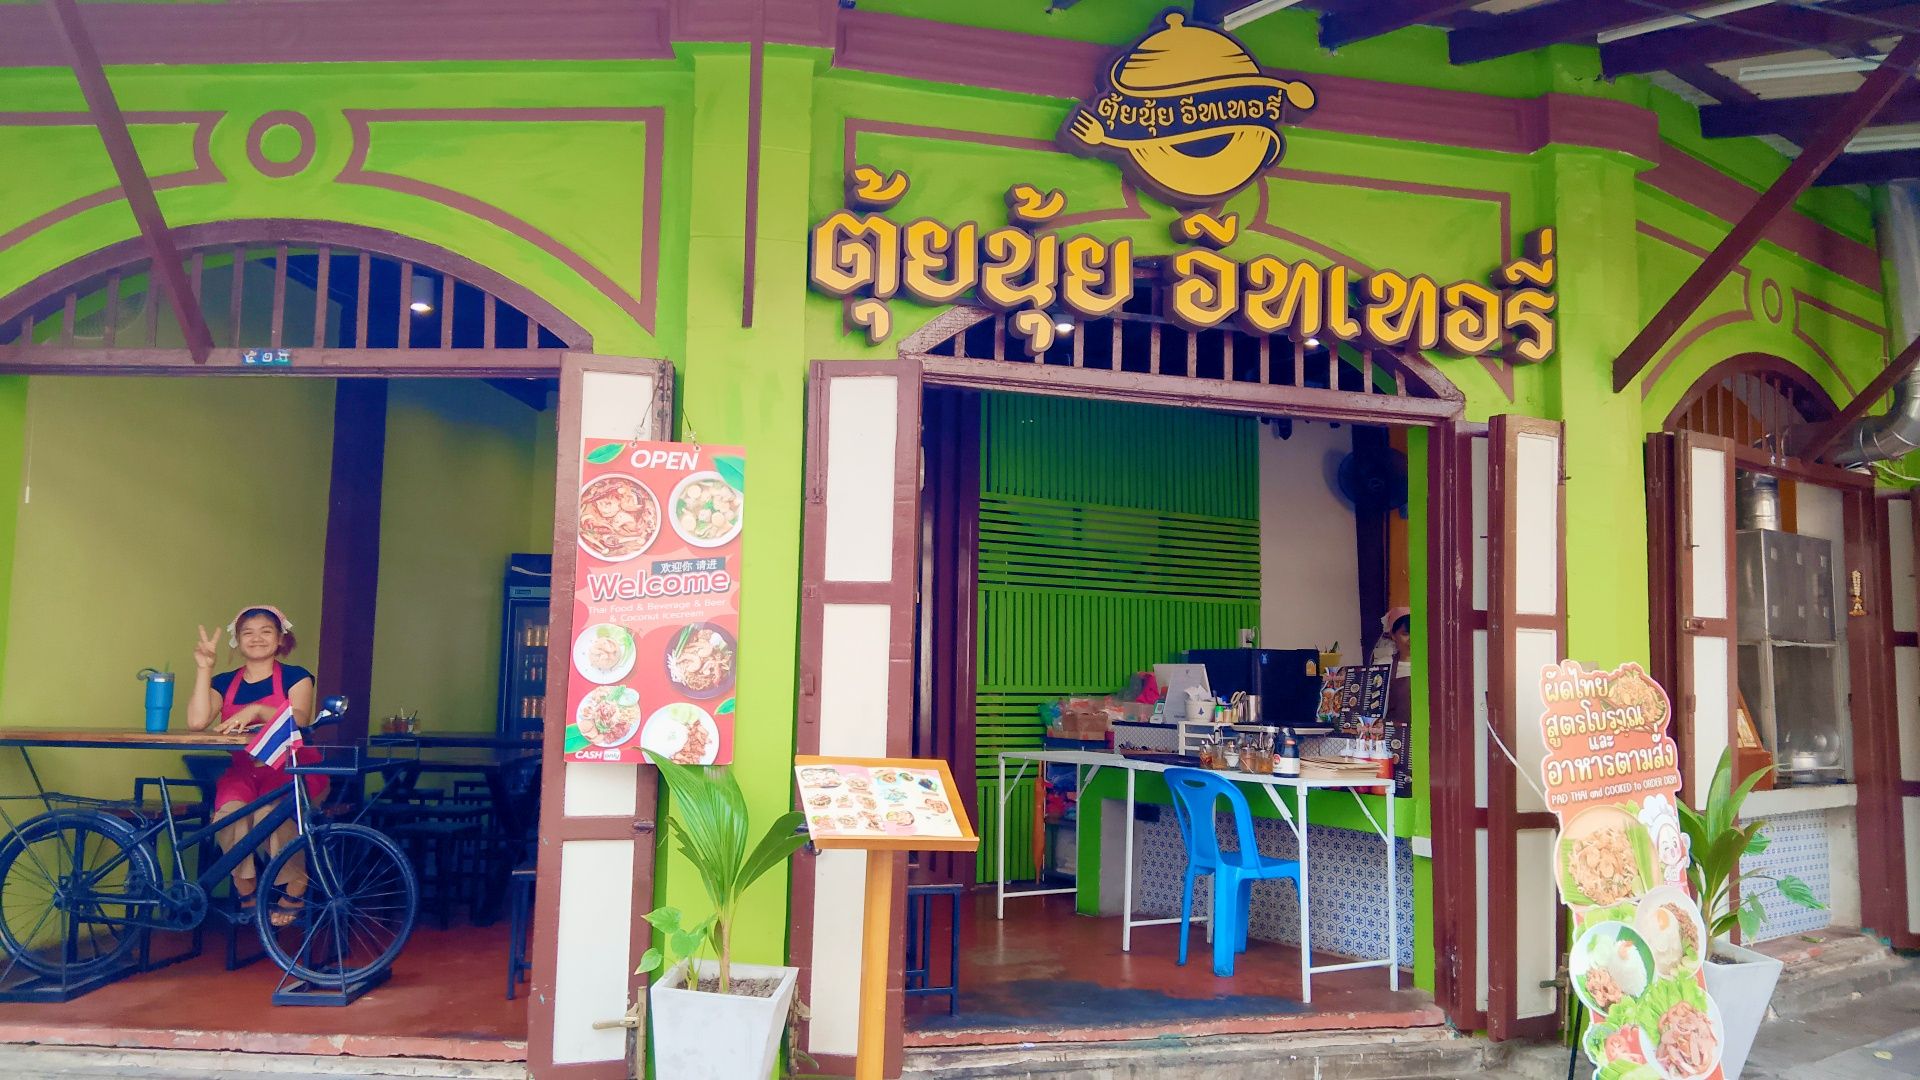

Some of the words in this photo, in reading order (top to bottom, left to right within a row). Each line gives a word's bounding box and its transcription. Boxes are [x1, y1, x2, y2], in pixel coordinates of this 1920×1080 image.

[810, 166, 1133, 351] ตุ้ยนุ้ย
[630, 449, 699, 471] OPEN
[660, 560, 693, 574] 欢迎你
[695, 558, 718, 571] 请进
[587, 569, 731, 602] Welcome
[588, 605, 607, 614] Thai
[610, 603, 634, 613] Food
[636, 602, 644, 611] &
[694, 599, 702, 607] &
[704, 598, 726, 607] Beer
[609, 615, 617, 623] &
[621, 613, 659, 622] Coconut
[1544, 667, 1609, 701] ผัดไทย
[1545, 699, 1645, 748] สูตรโบราณ
[575, 750, 603, 759] CASH
[604, 752, 620, 760] only
[1547, 722, 1674, 786] อาหารตามสั่ง
[1588, 735, 1615, 751] และ
[1551, 794, 1569, 805] PAD
[1571, 790, 1588, 801] THAI
[1590, 788, 1603, 799] and
[1604, 783, 1632, 797] COOKED
[1634, 781, 1642, 791] to
[1643, 777, 1663, 789] ORDER
[1663, 774, 1678, 786] DISH
